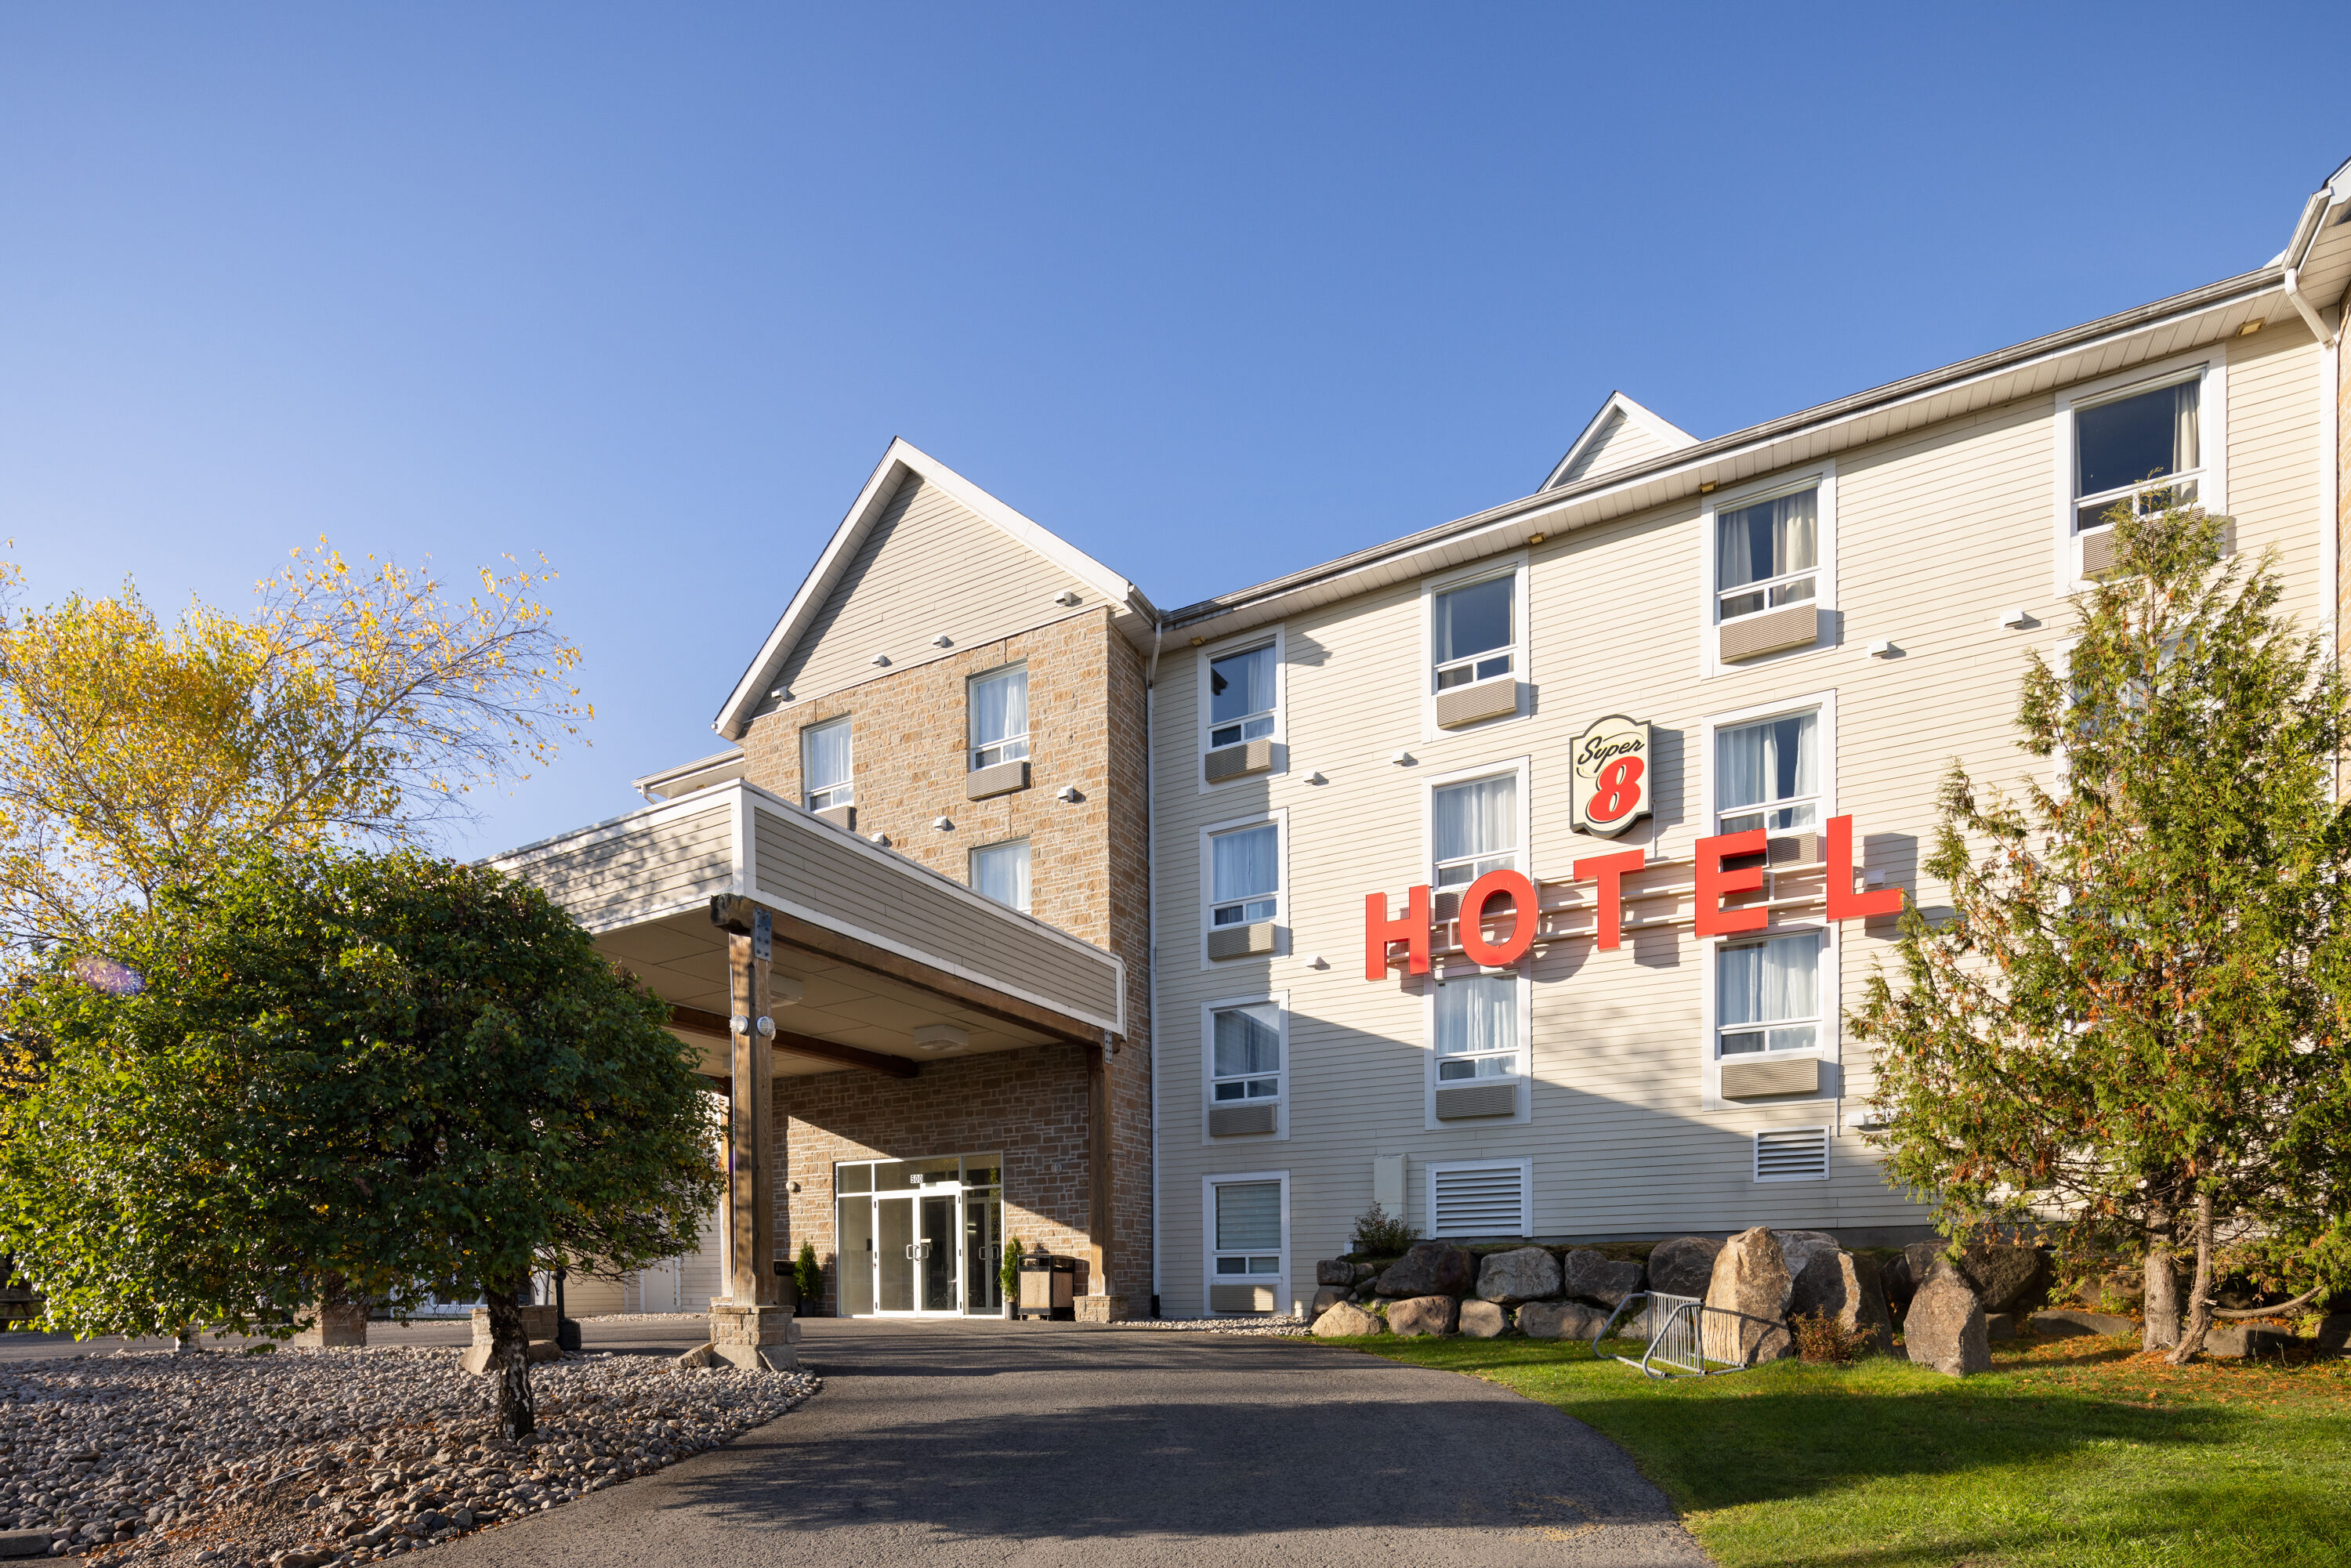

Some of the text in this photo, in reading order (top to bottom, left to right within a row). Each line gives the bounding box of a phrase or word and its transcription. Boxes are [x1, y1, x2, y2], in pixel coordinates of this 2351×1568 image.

[1578, 736, 1645, 773] Super
[1585, 755, 1644, 824] 8
[1366, 815, 1904, 981] HOTEL
[911, 1175, 922, 1183] 500
